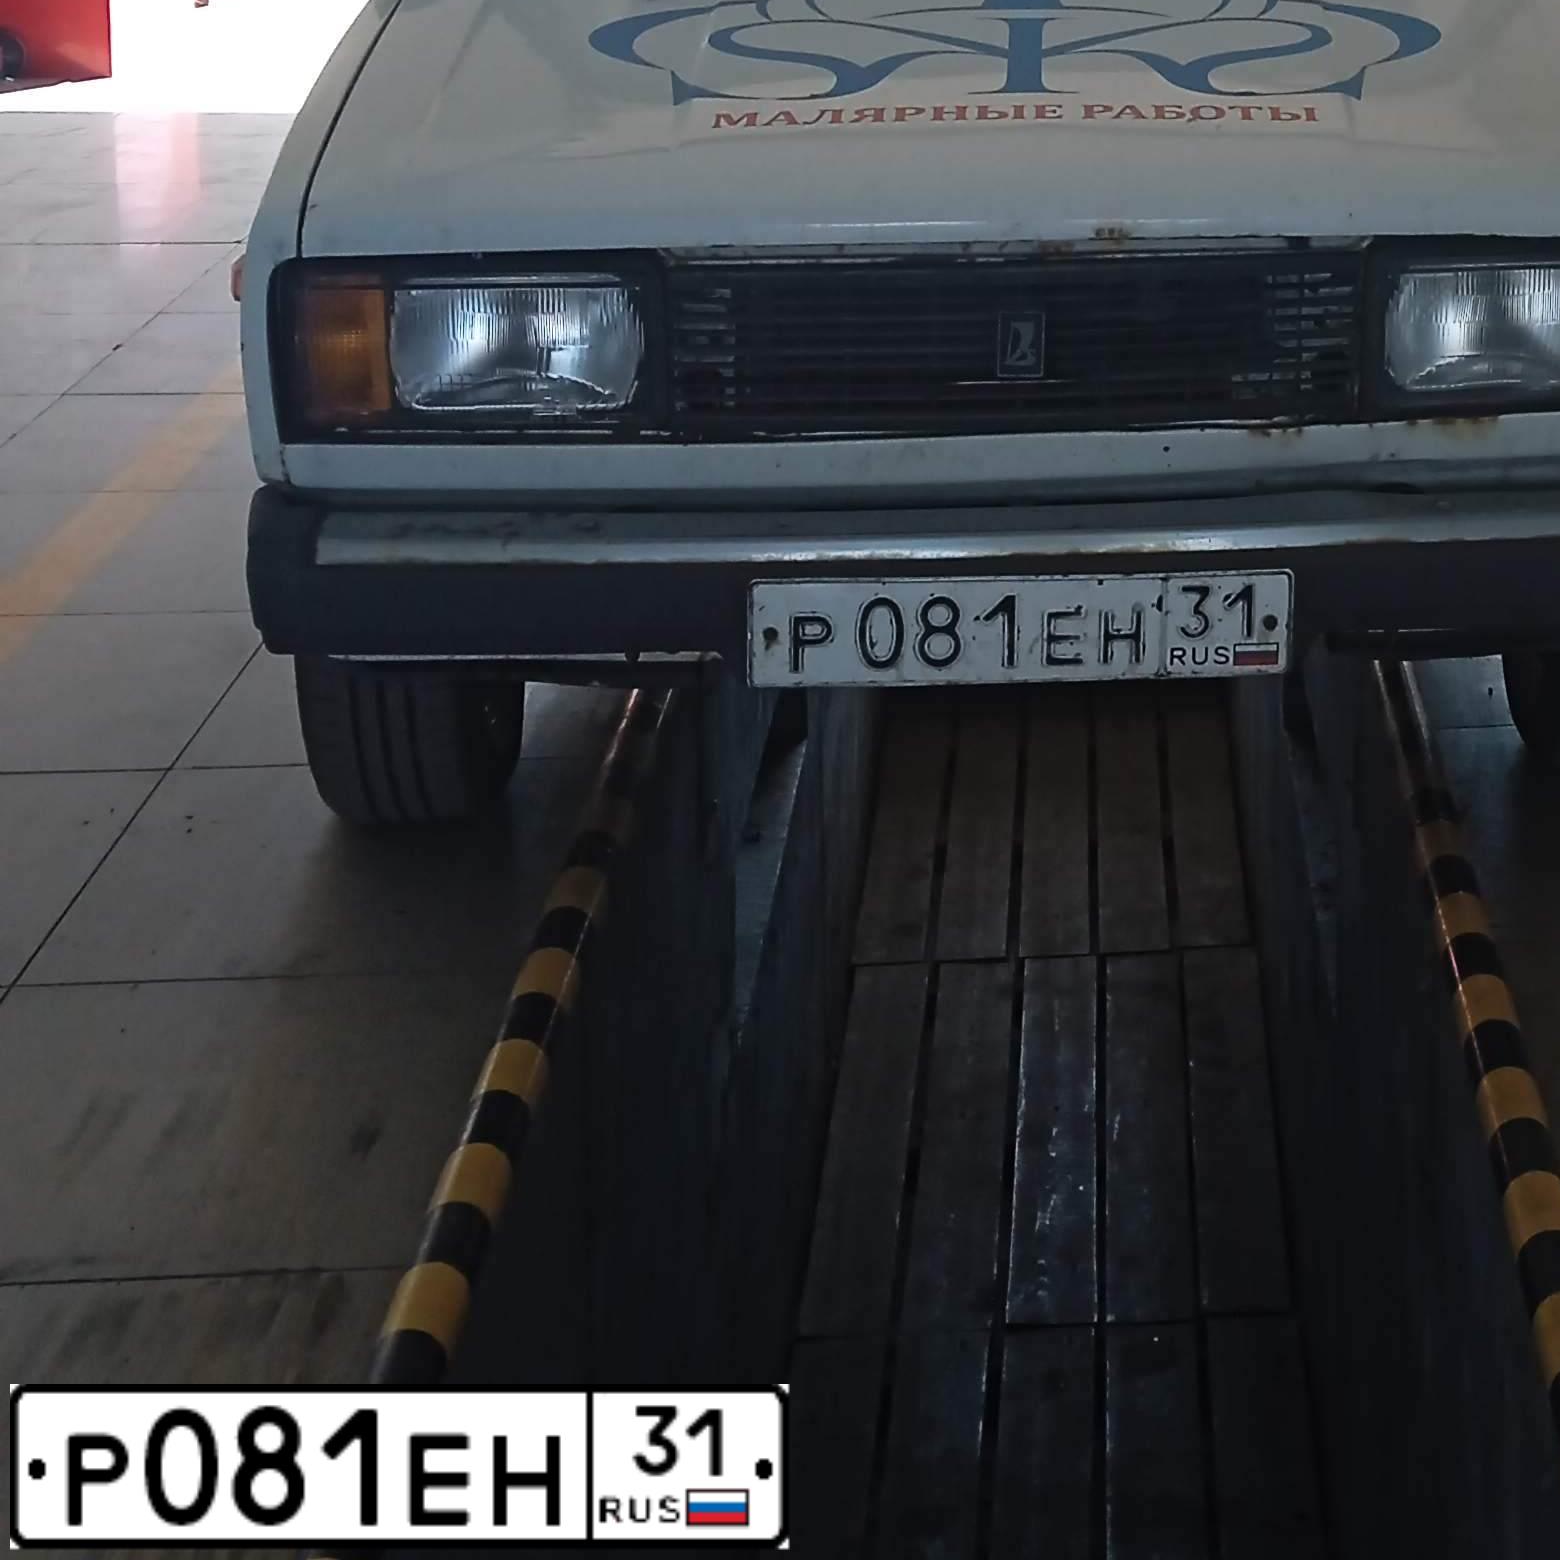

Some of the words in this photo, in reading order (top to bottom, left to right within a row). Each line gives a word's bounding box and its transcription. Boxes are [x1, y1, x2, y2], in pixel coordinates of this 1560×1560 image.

[711, 104, 1065, 129] МАЛЯРНЫЕ
[1081, 104, 1319, 123] РАБОТЫ
[1180, 584, 1254, 638] 31
[1169, 646, 1231, 667] RUS
